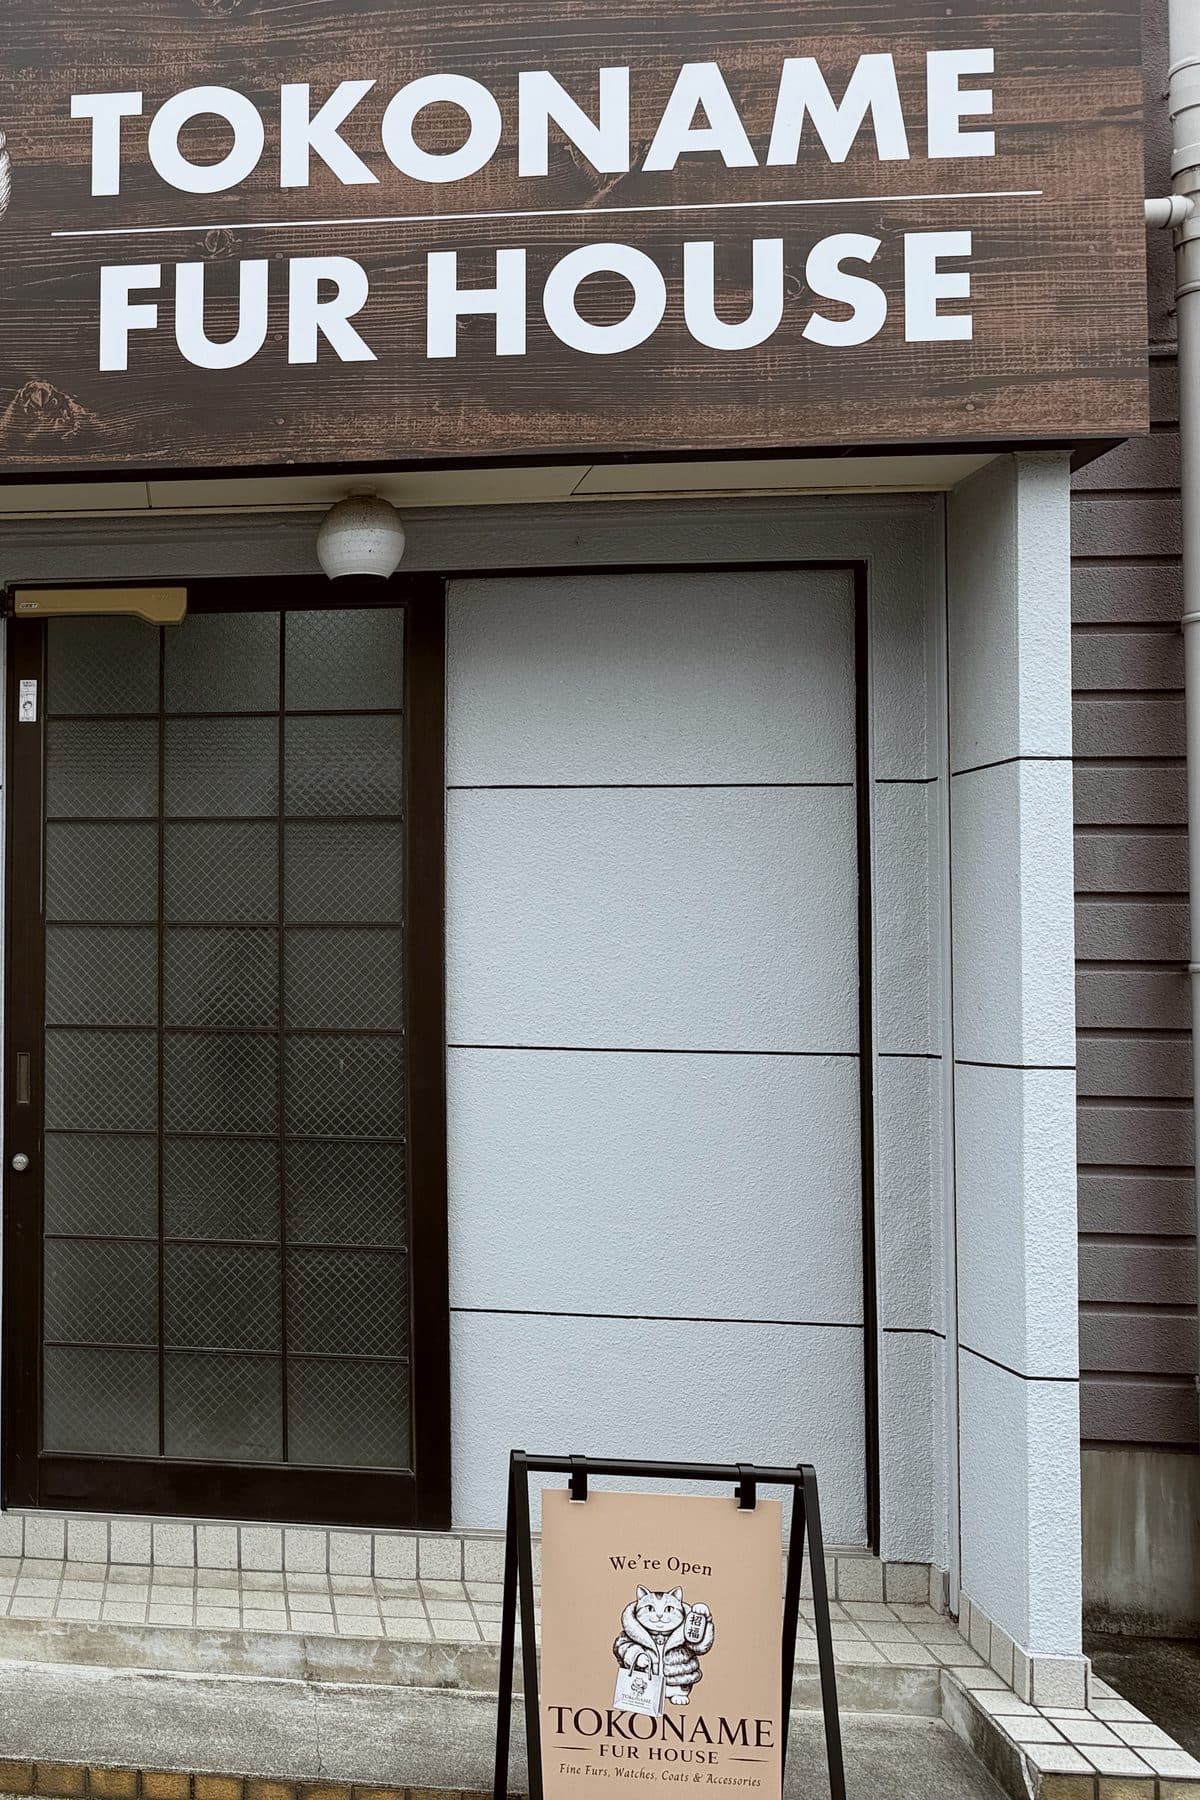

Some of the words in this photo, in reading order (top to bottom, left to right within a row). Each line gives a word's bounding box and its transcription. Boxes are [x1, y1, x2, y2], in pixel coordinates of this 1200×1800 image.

[69, 47, 996, 196] TOKONAME
[97, 255, 377, 372] FUR
[426, 231, 973, 359] HOUSE
[667, 1556, 713, 1577] Open
[687, 1614, 703, 1640] 招福
[547, 1706, 775, 1748] TOKONAME
[599, 1743, 639, 1760] FUR
[648, 1747, 719, 1765] HOUSE
[559, 1763, 582, 1775] Fine
[585, 1765, 611, 1778] Furs,
[615, 1767, 658, 1782] Watches,
[661, 1770, 689, 1783] Coats
[692, 1772, 704, 1784] &
[705, 1773, 762, 1788] Accessories
